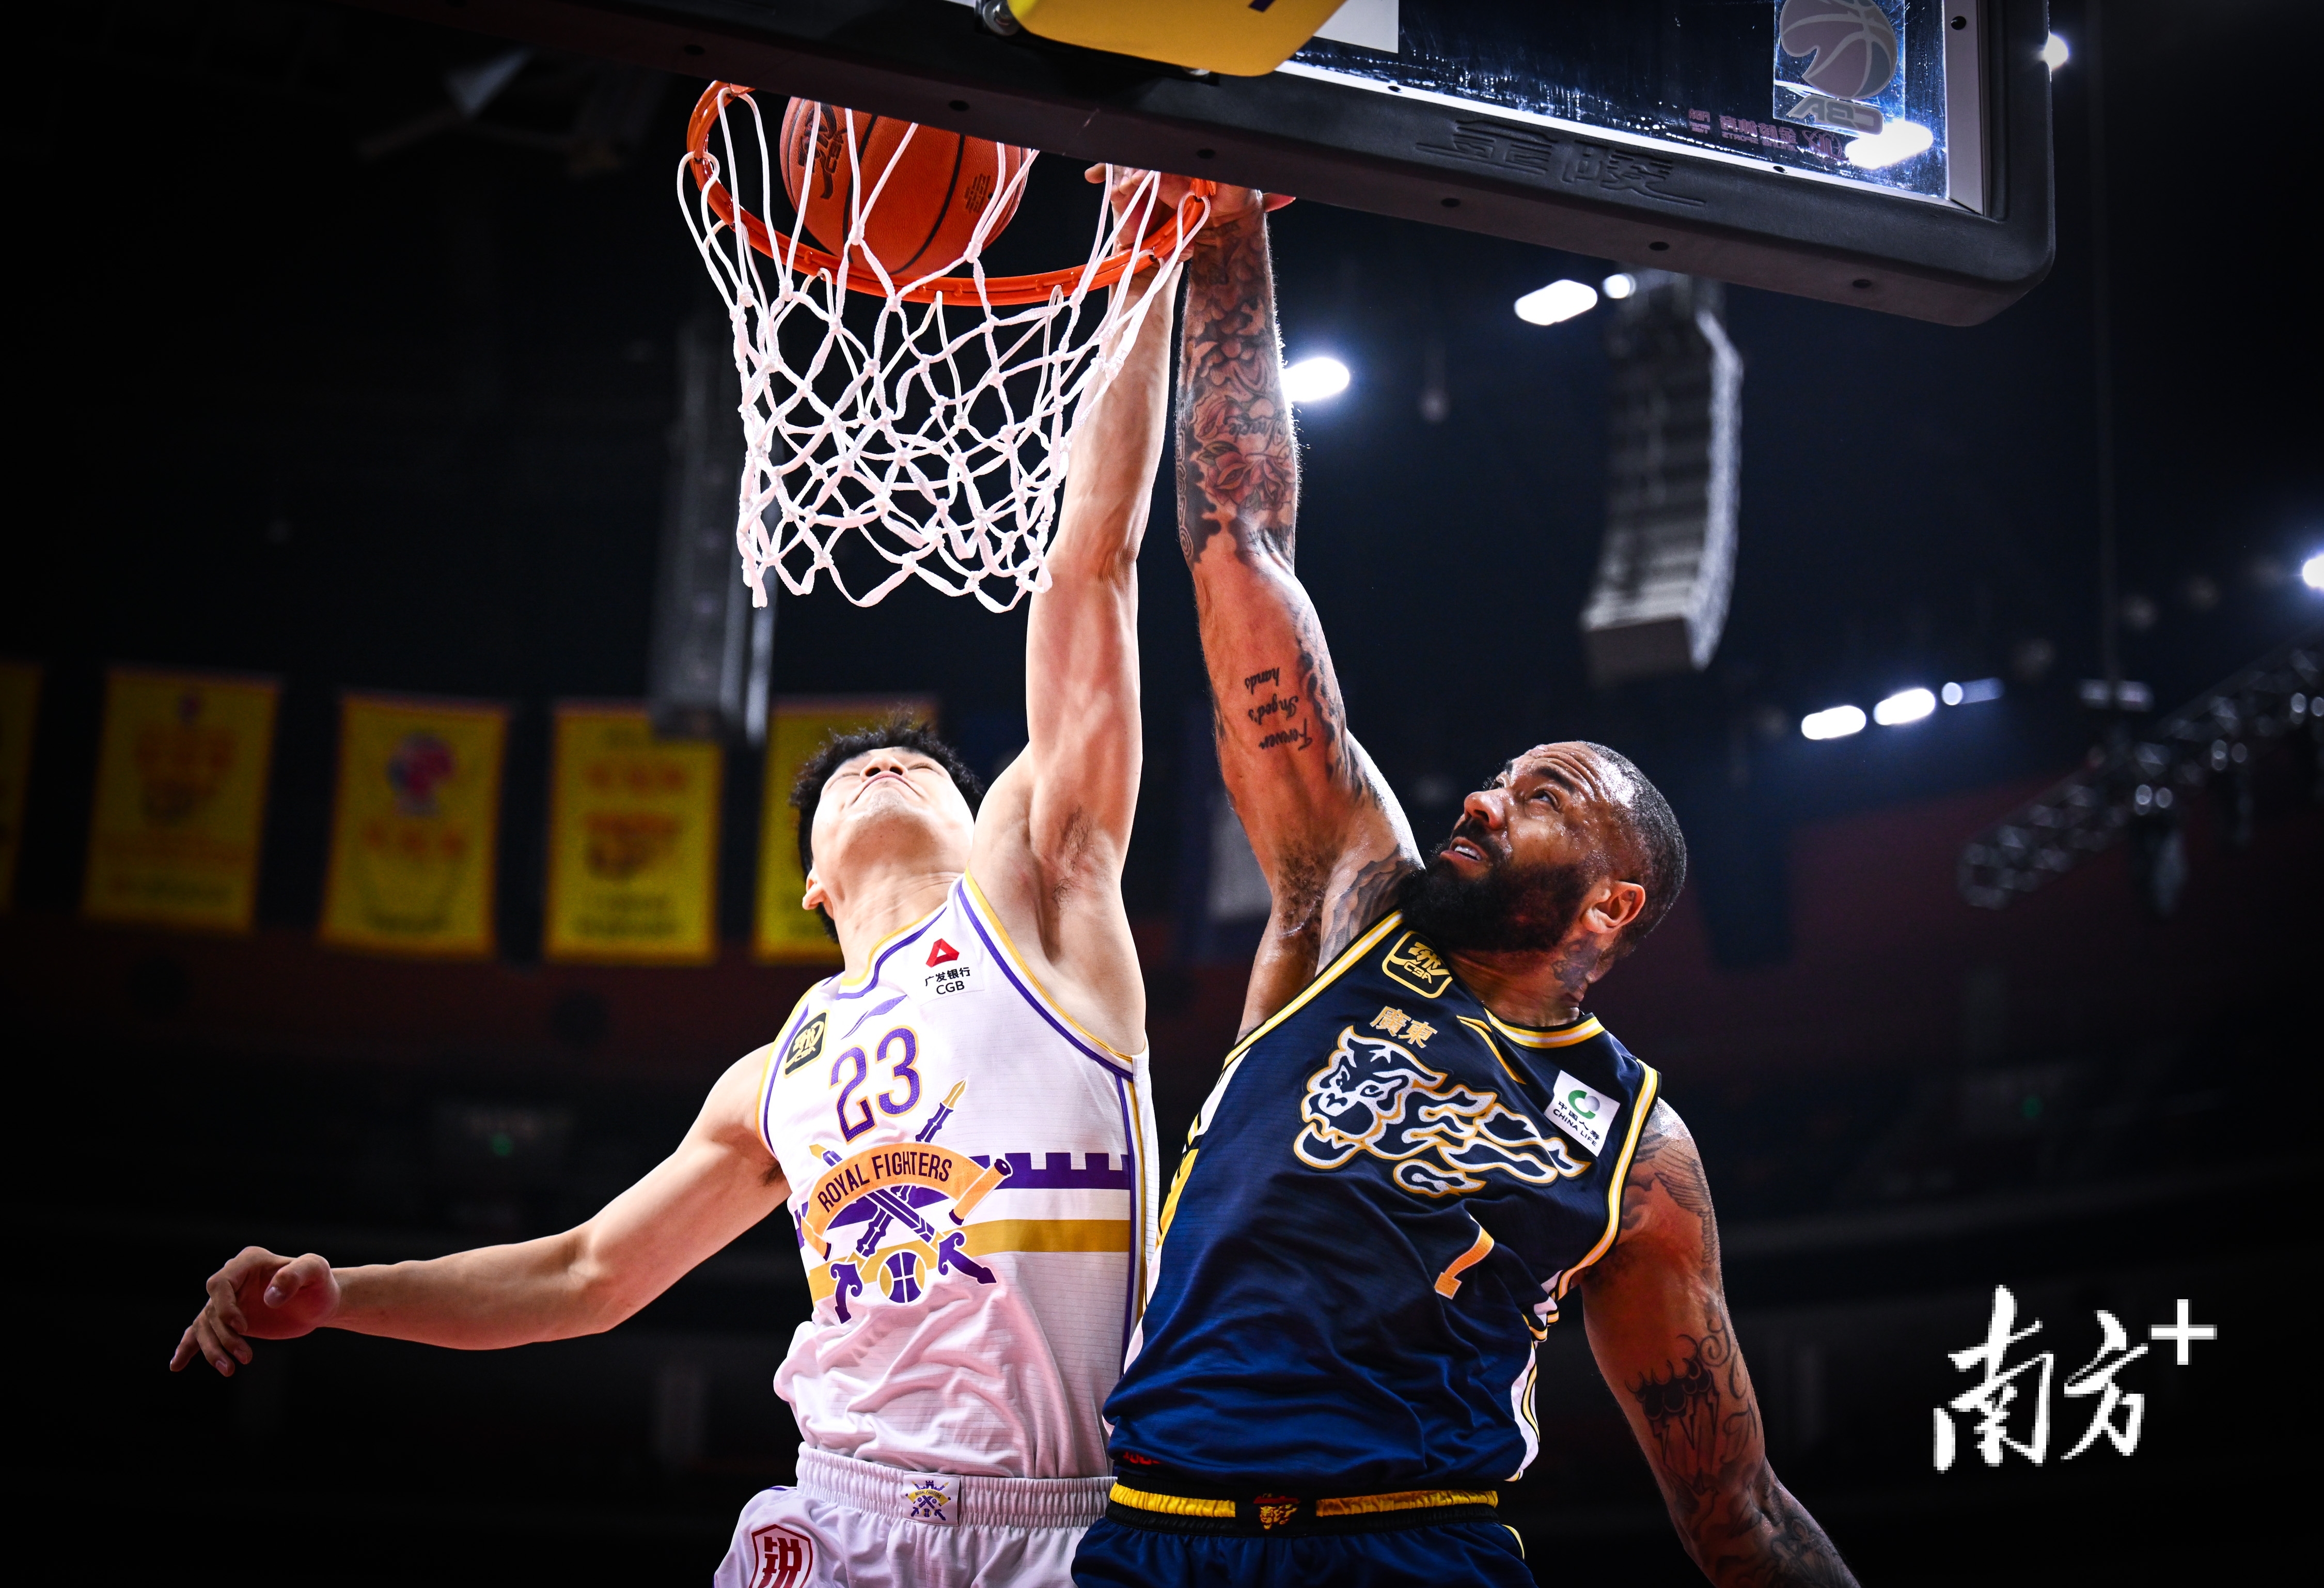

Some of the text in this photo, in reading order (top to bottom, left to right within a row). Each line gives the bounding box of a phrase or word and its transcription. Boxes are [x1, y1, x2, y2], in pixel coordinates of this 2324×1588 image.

[1245, 667, 1280, 695] hands
[1259, 718, 1312, 752] Forever
[924, 966, 971, 987] 广发银行
[936, 980, 965, 995] CGB
[1403, 961, 1432, 984] CBA
[1369, 1005, 1438, 1049] 廣東
[829, 1025, 922, 1144] 23
[1553, 1109, 1597, 1147] CHINA LIFE
[1558, 1100, 1600, 1140] 中国人寿
[817, 1151, 953, 1213] ROYAL FIGHTERS
[926, 1490, 942, 1499] FIGHTERS
